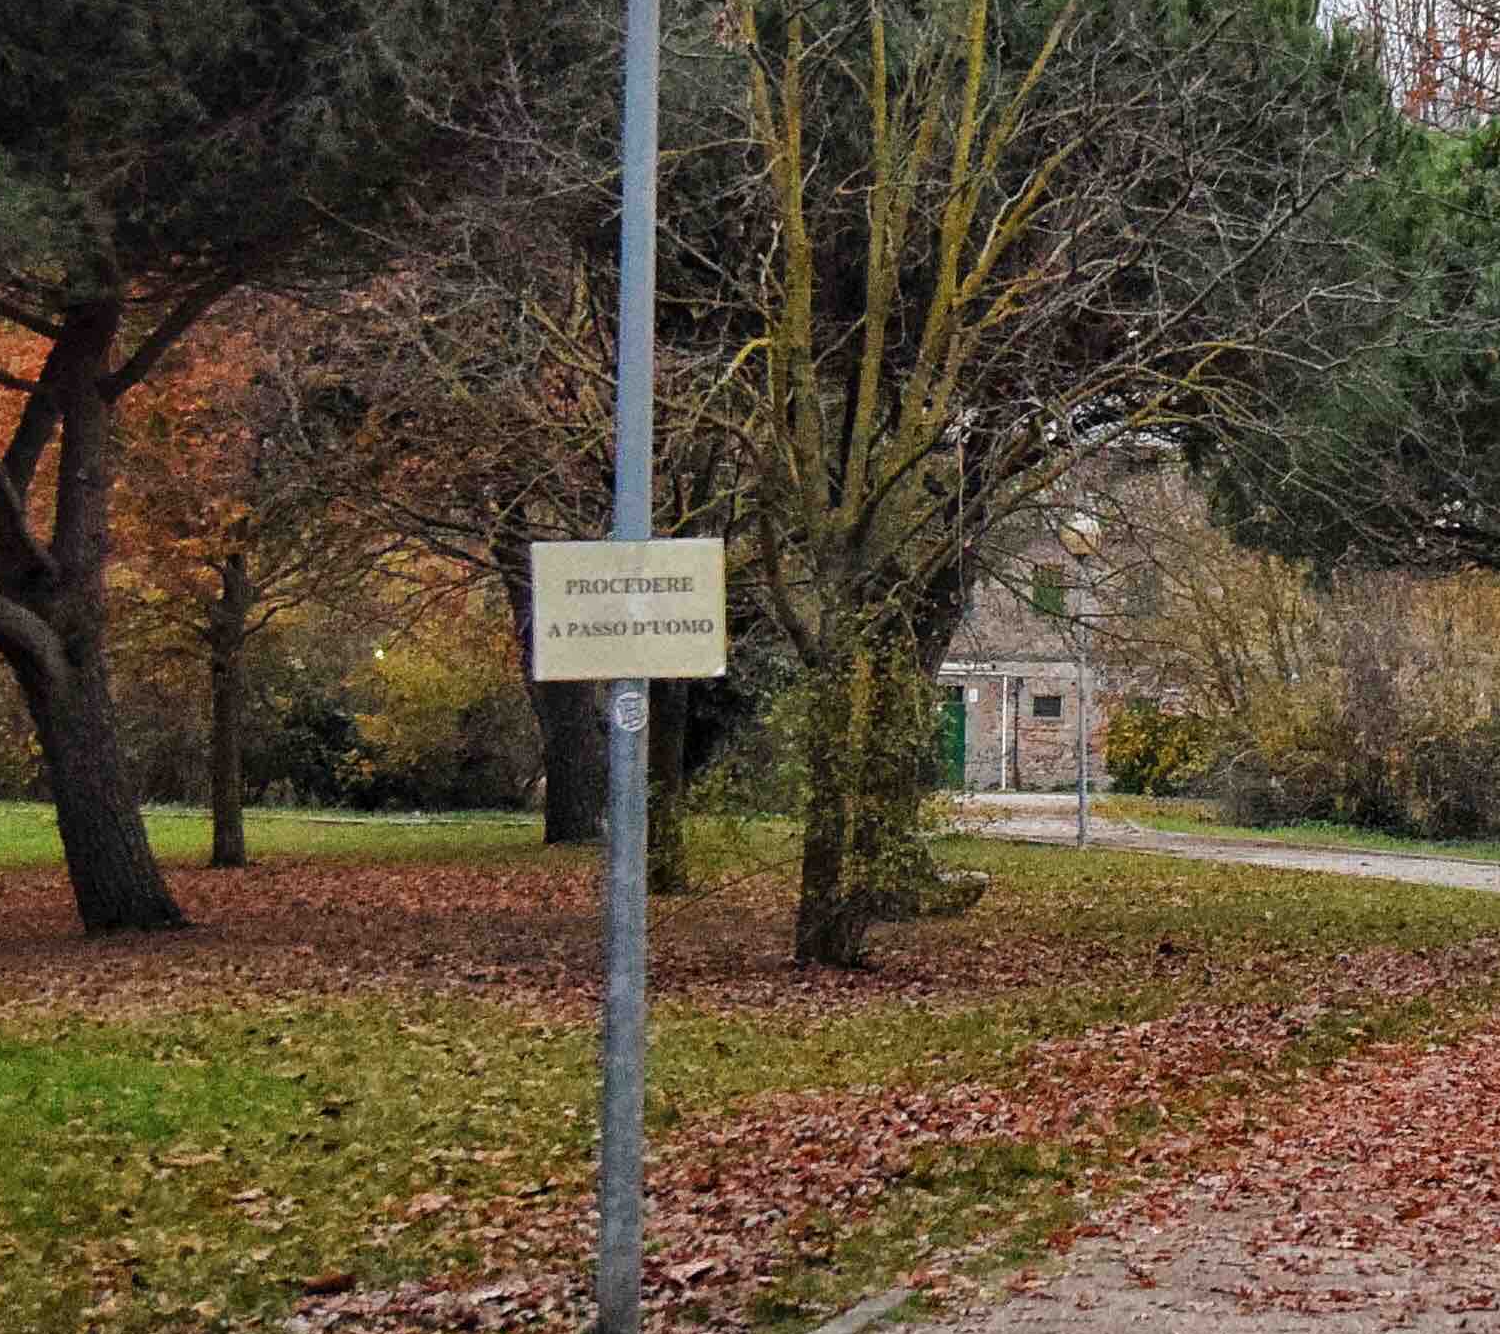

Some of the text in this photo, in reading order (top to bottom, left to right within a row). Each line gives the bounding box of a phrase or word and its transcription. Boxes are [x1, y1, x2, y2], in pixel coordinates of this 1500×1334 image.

[565, 576, 693, 595] PROCEDERE
[549, 618, 714, 637] A PASSO D'UOMO
